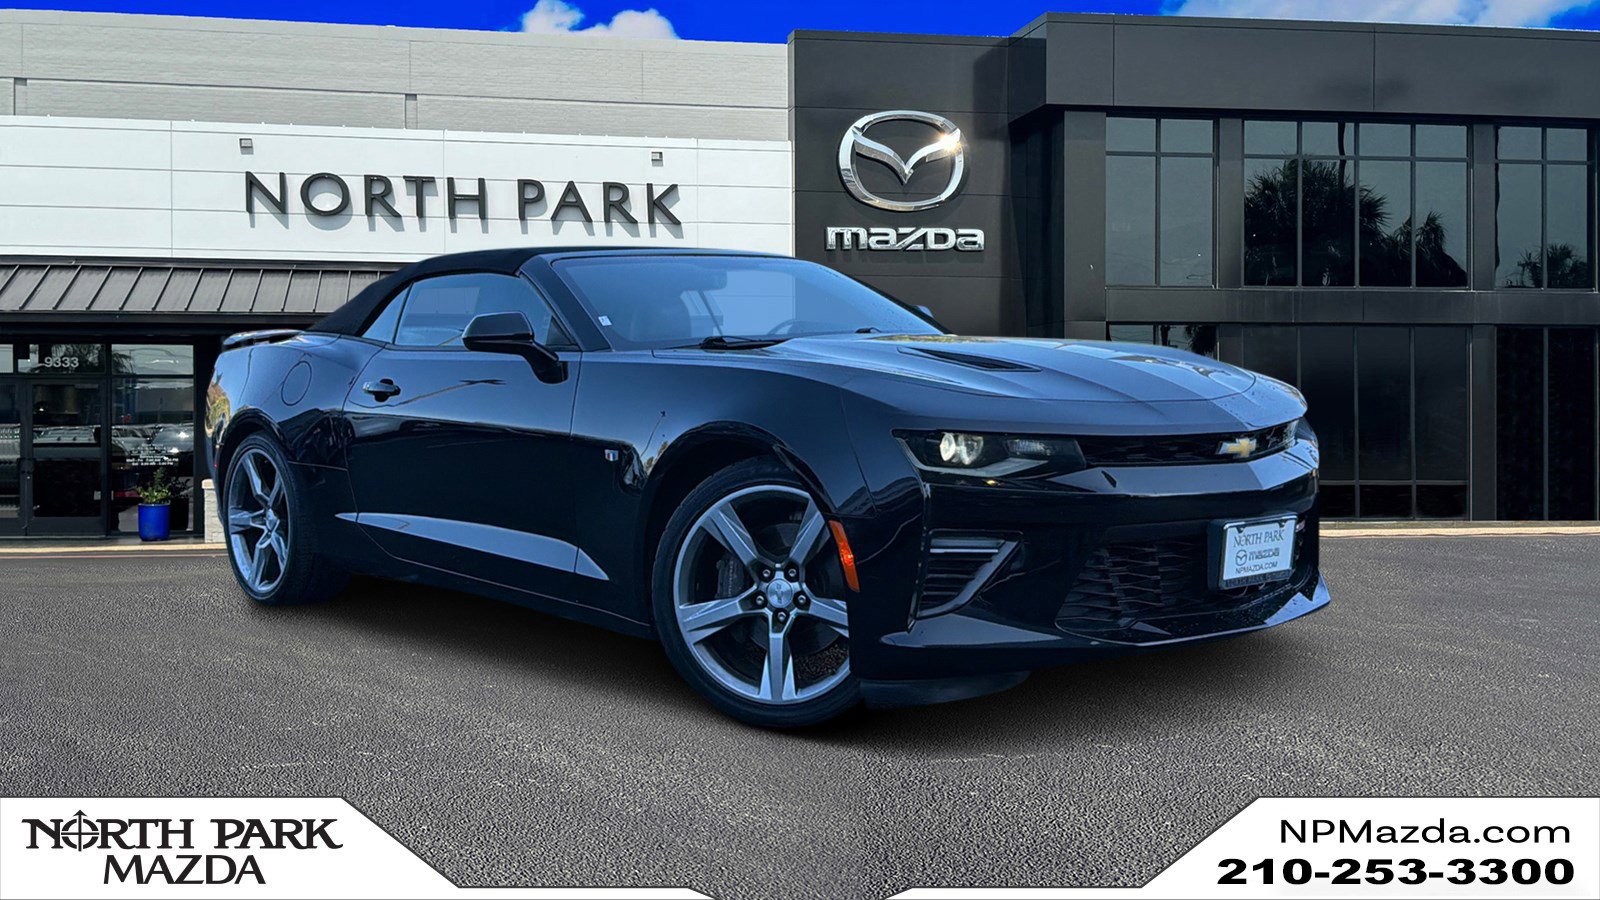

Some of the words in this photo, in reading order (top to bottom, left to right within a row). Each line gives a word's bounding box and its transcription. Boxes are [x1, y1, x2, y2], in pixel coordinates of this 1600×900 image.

[245, 171, 486, 220] NORTH
[517, 178, 682, 225] PARK
[826, 226, 985, 251] mazda
[44, 356, 79, 368] 9333
[1233, 532, 1263, 548] NORTH
[1264, 529, 1285, 543] PARK
[1248, 548, 1280, 561] mazda
[1235, 561, 1278, 574] NPMAZDA.COM
